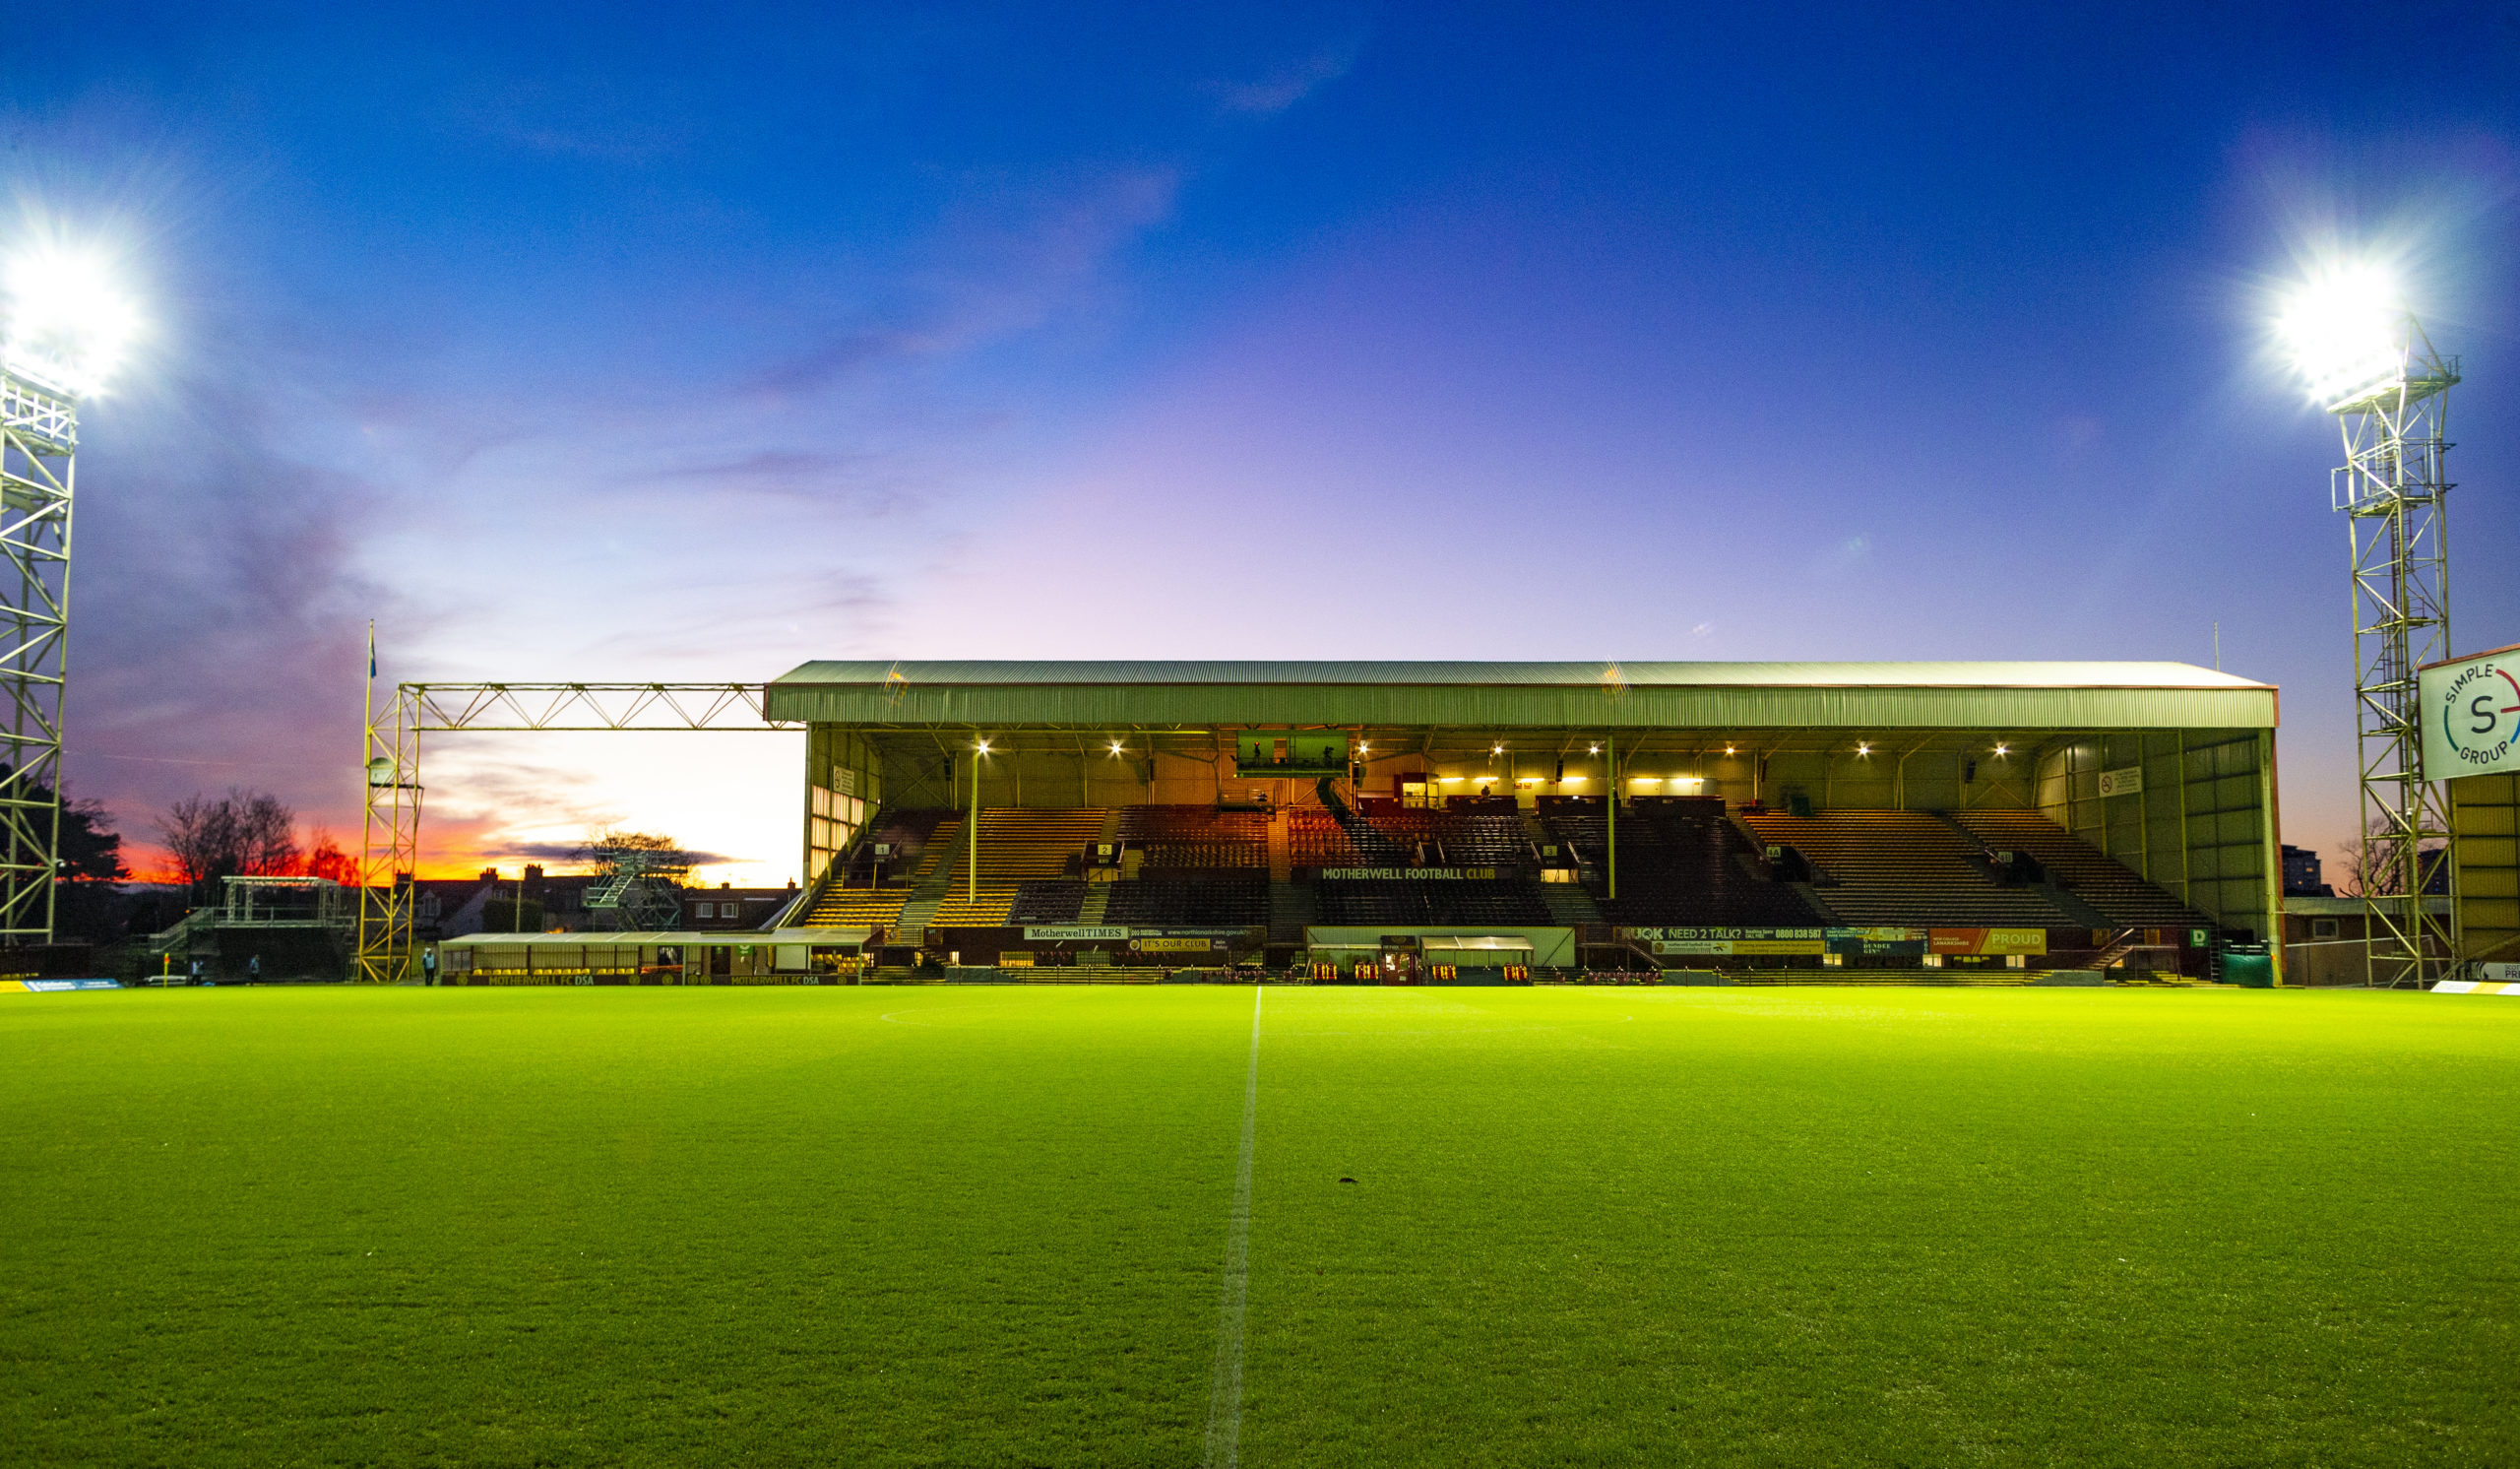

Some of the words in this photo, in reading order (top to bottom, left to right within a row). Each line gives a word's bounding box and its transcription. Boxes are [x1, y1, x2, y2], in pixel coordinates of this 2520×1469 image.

[2445, 664, 2493, 704] SIMPLE
[2471, 695, 2496, 734] S
[2460, 740, 2507, 765] GROUP
[1322, 867, 1402, 879] MOTHERWELL
[1405, 867, 1464, 879] FOOTBALL
[1466, 867, 1495, 879] CLUB
[1668, 928, 1698, 938] NEED
[1700, 928, 1707, 938] 2
[1710, 928, 1741, 938] TALK?
[1795, 928, 1807, 938] 838
[1808, 928, 1821, 938] 587
[1992, 933, 2042, 945] PROUD
[2193, 929, 2206, 942] D
[489, 975, 558, 986] MOTHERWELL
[560, 975, 573, 986] FC
[575, 975, 595, 986] DSA
[731, 976, 788, 986] MOTHERWELL
[790, 976, 801, 986] FC
[802, 976, 820, 986] DSA
